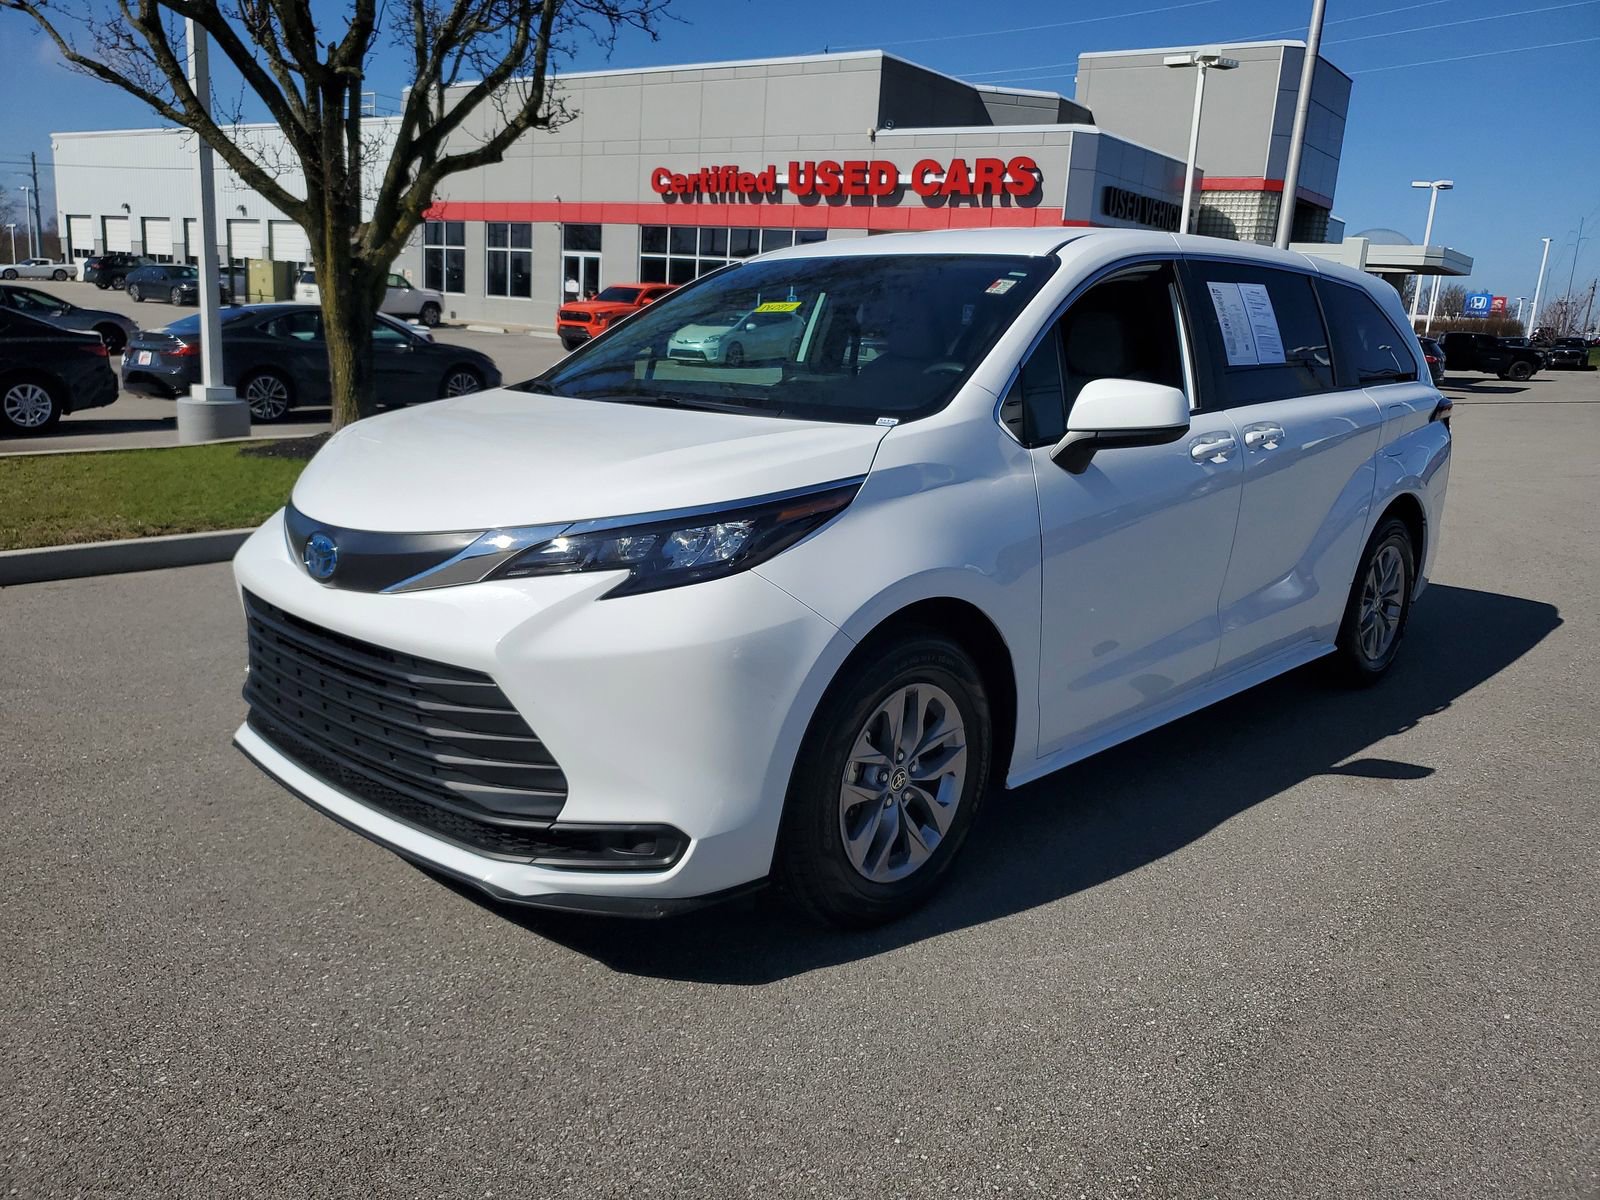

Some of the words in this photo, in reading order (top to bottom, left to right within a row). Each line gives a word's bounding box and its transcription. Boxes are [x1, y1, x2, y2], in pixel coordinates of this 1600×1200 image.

[651, 165, 777, 194] Certified
[788, 160, 898, 196] USED
[911, 156, 1038, 197] CARS
[1109, 187, 1141, 221] USED
[1145, 197, 1194, 233] VEHICL
